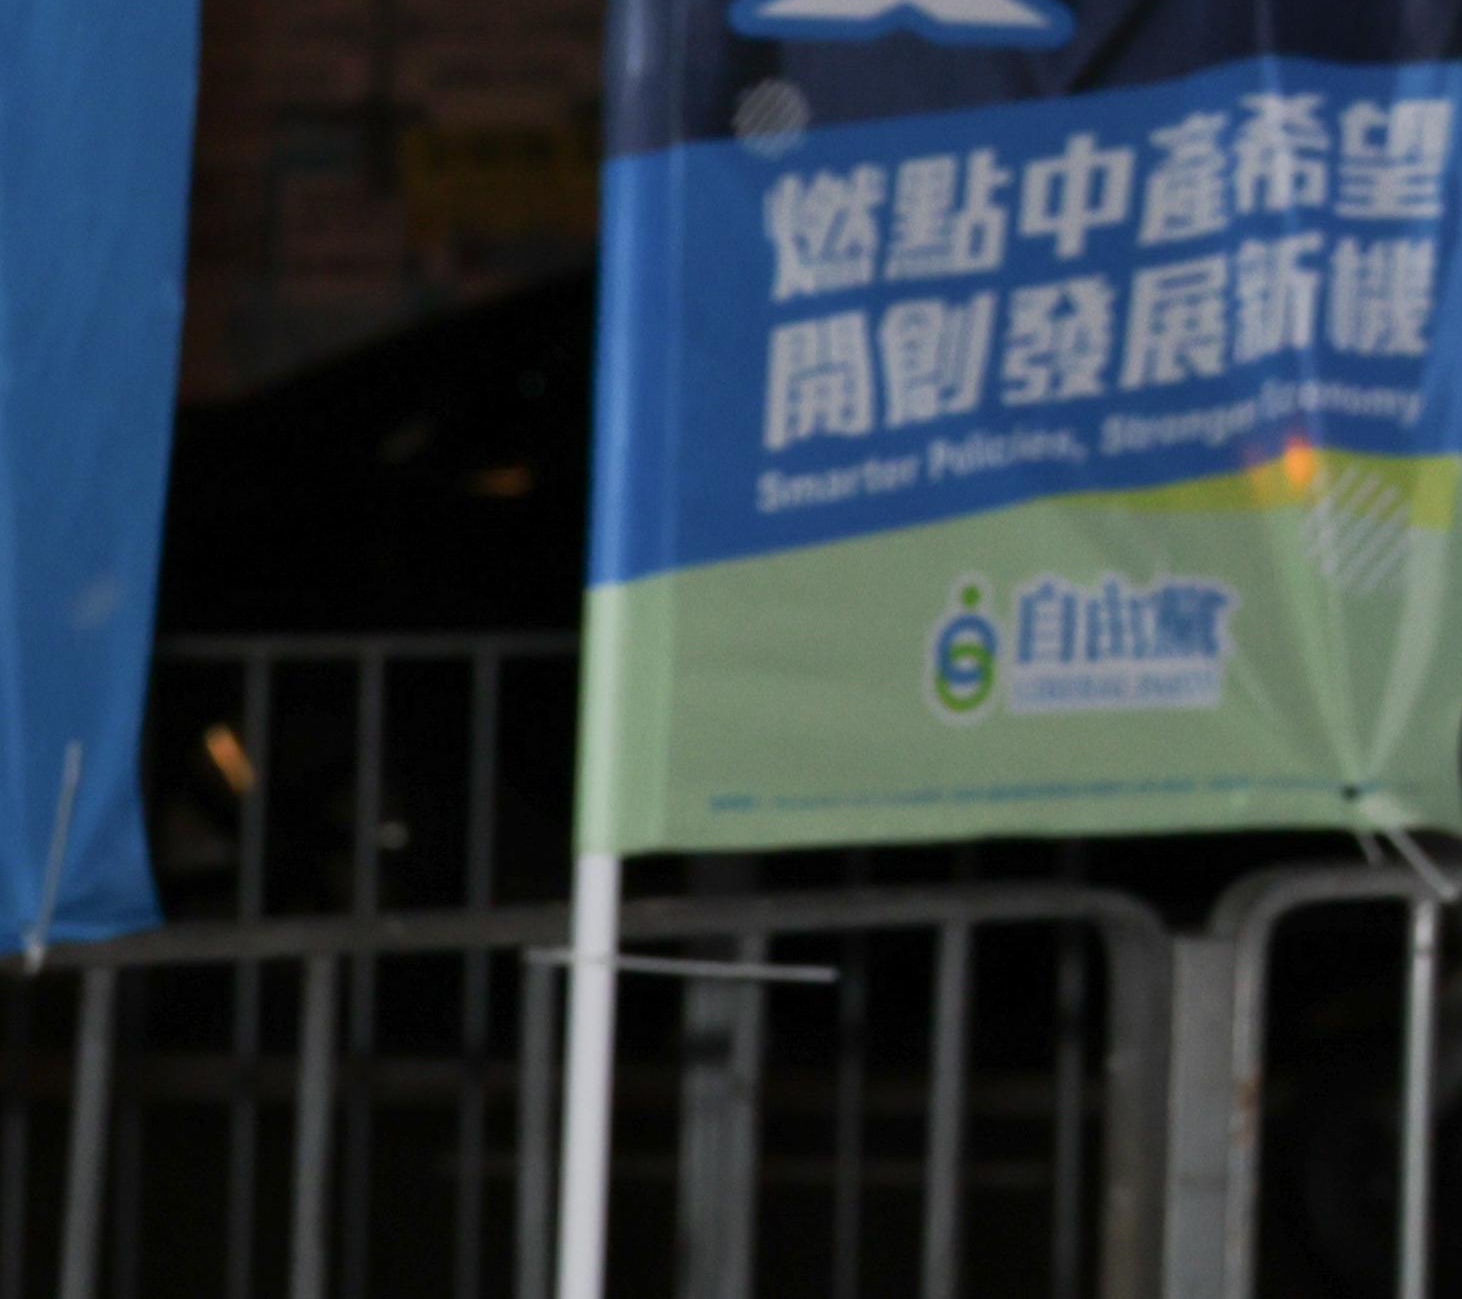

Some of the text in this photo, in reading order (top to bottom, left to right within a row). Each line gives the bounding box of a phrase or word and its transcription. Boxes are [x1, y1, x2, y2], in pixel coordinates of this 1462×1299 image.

[764, 93, 1454, 301] 燃點中產希望
[764, 231, 1436, 452] 開創發展新機
